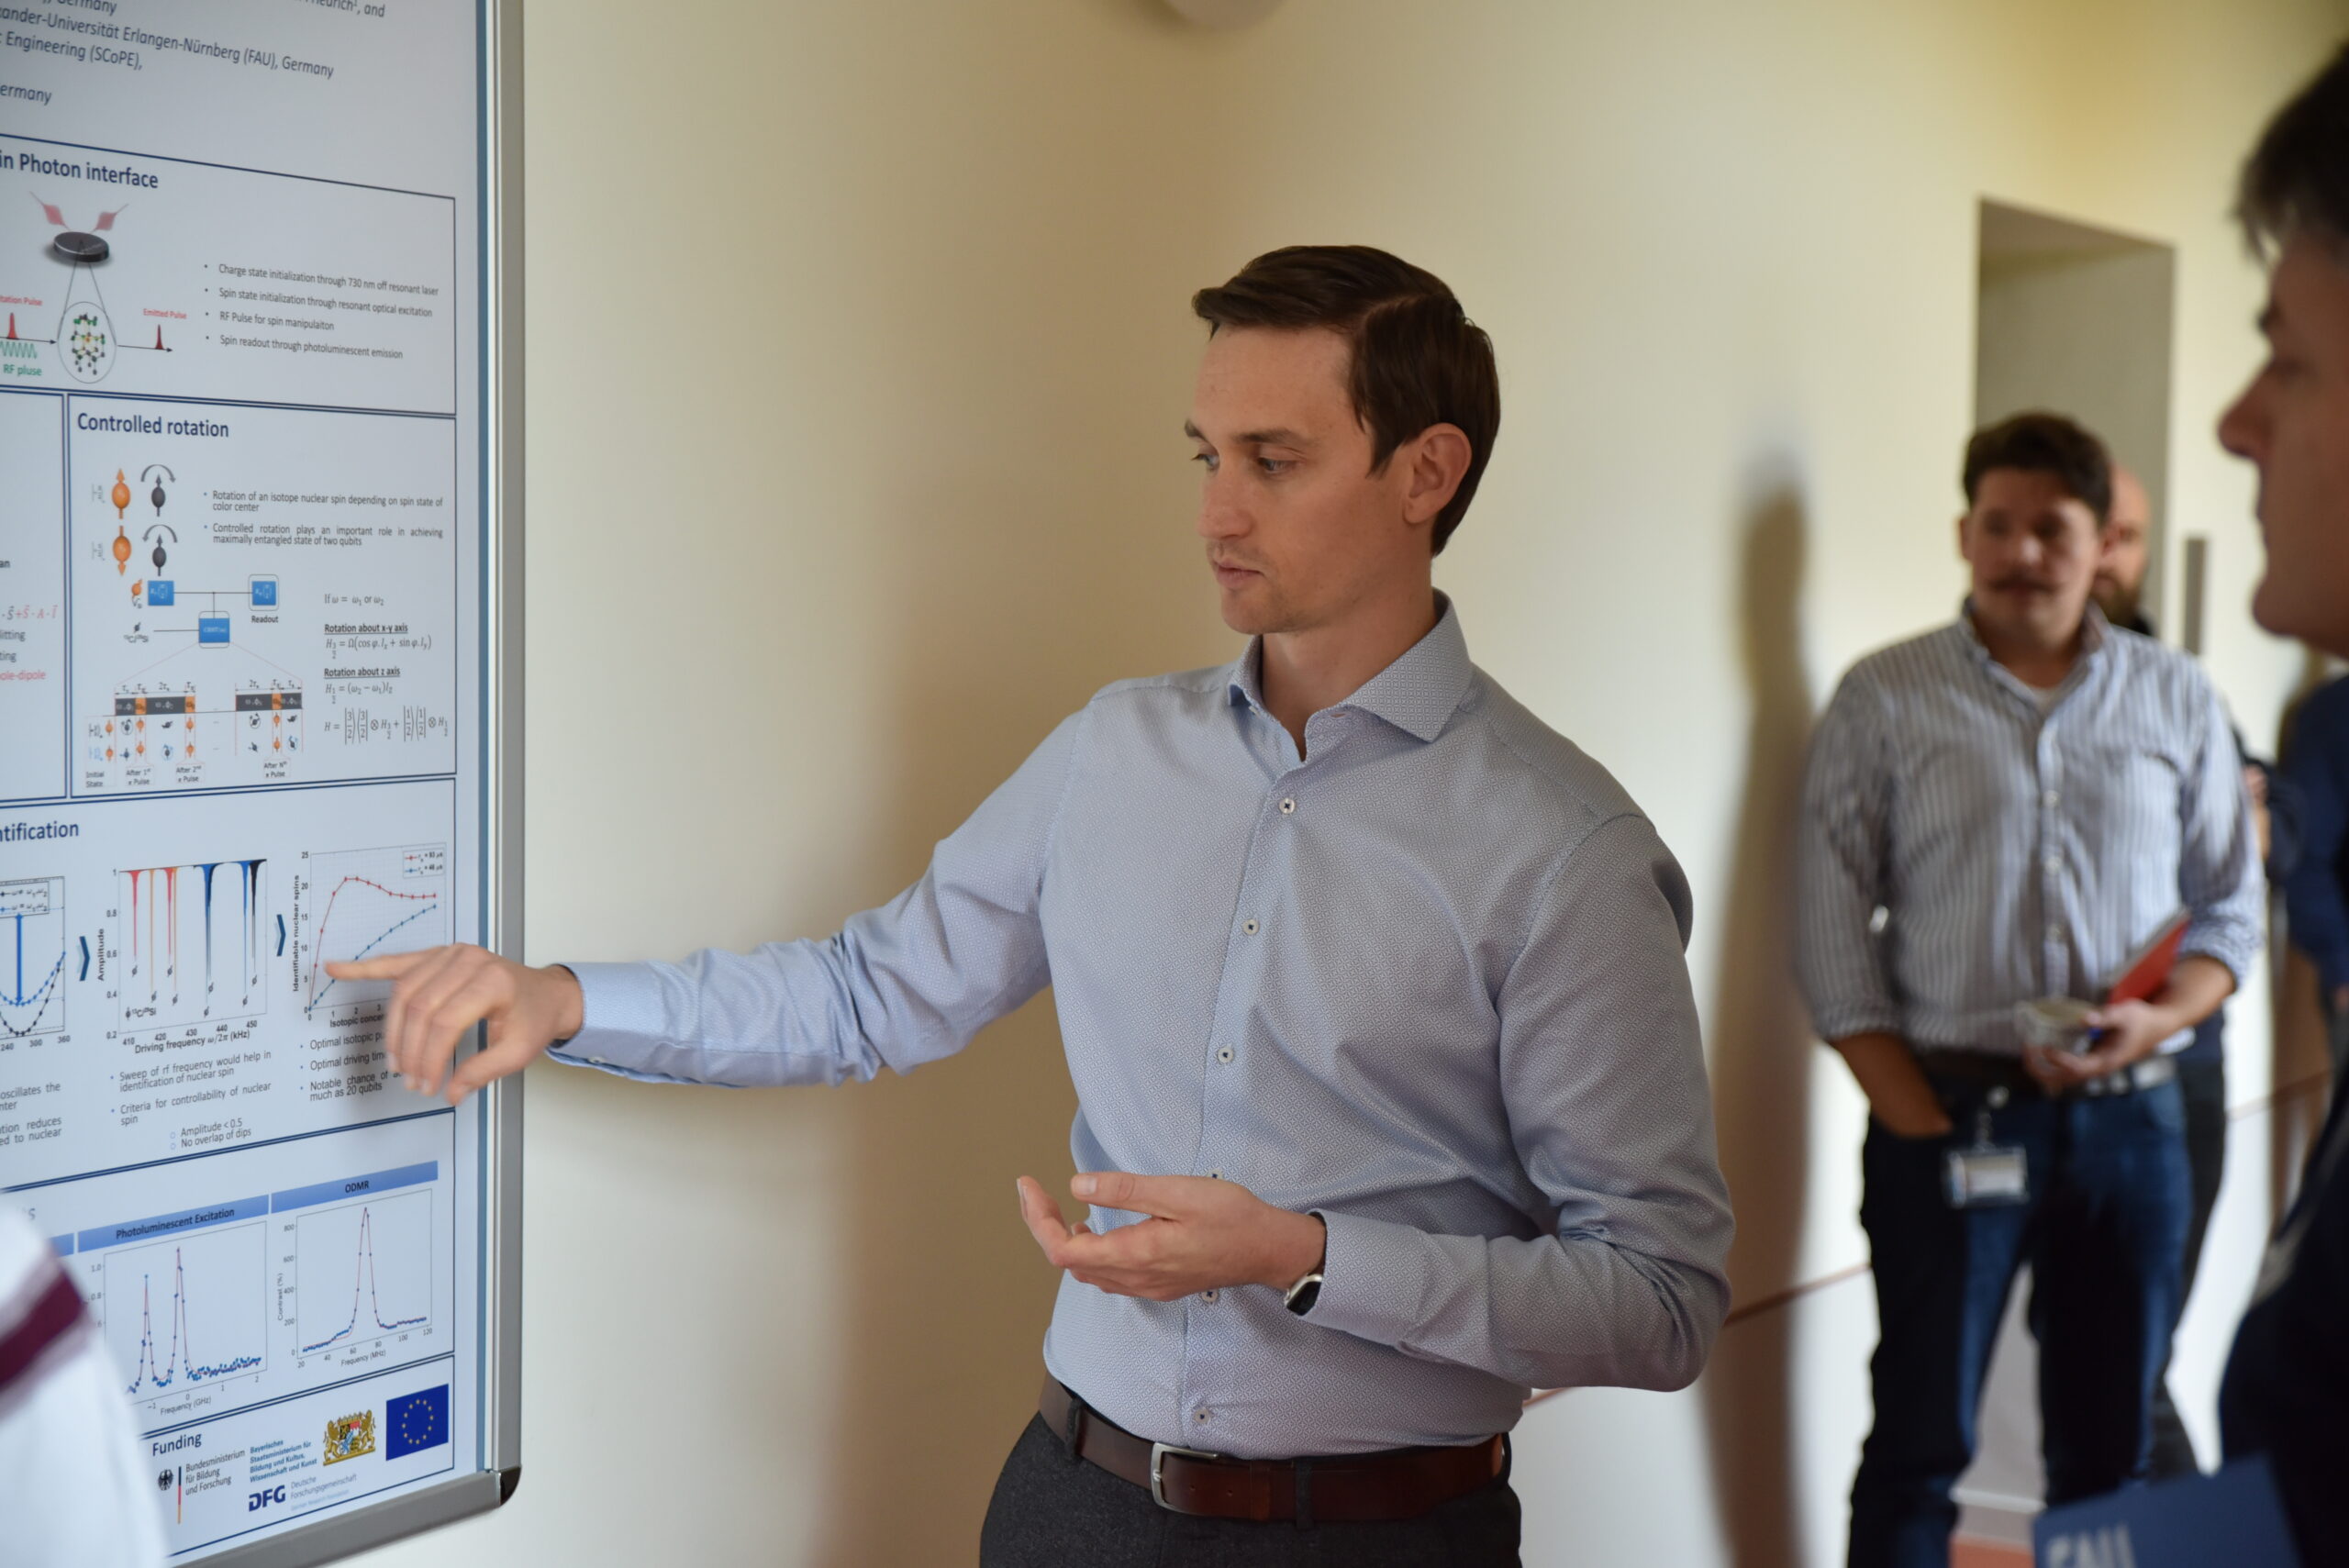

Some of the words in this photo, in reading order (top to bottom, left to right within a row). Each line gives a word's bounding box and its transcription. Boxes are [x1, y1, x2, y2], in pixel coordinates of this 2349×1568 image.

[363, 4, 385, 17] and
[6, 31, 86, 61] Engineering
[90, 45, 142, 71] (SCoPE),
[123, 27, 240, 63] Erlangen-Nürnberg
[243, 48, 279, 70] (FAU),
[282, 56, 334, 80] Germany
[0, 83, 52, 106] ermany
[20, 153, 81, 179] Photon
[86, 161, 159, 189] interface
[218, 263, 247, 277] Charge
[248, 268, 268, 278] state
[270, 269, 316, 284] initialization
[317, 274, 346, 288] through
[348, 277, 362, 288] 730
[363, 281, 375, 289] nm
[377, 281, 387, 291] off
[389, 284, 420, 295] resonant
[421, 285, 440, 296] laser
[219, 287, 237, 300] Spin
[238, 290, 258, 301] state
[259, 291, 306, 306] initialization
[307, 296, 337, 310] through
[339, 301, 371, 312] resonant
[372, 303, 397, 315] optical
[398, 306, 433, 317] excitation
[220, 311, 230, 321] RF
[231, 312, 253, 324] Pulse
[254, 314, 266, 325] for
[267, 317, 284, 328] spin
[220, 334, 238, 347] Spin
[239, 337, 271, 349] readout
[272, 339, 302, 353] through
[303, 342, 371, 357] photoluminescent
[371, 349, 404, 360] emission
[3, 363, 15, 374] RF
[77, 412, 162, 434] Controlled
[167, 418, 229, 438] rotation
[212, 490, 247, 501] Rotation
[248, 491, 257, 502] of
[259, 493, 269, 502] an
[271, 492, 299, 504] isotope
[301, 493, 329, 505] nuclear
[330, 494, 347, 506] spin
[348, 495, 386, 507] depending
[388, 496, 398, 506] on
[399, 496, 415, 507] spin
[416, 497, 434, 507] state
[435, 497, 444, 507] of
[212, 501, 233, 512] color
[234, 503, 260, 512] center
[212, 522, 254, 533] Controlled
[260, 524, 291, 534] rotation
[295, 524, 316, 537] plays
[321, 526, 331, 535] an
[336, 525, 373, 538] important
[378, 526, 393, 537] role
[396, 526, 406, 537] in
[410, 526, 443, 539] achieving
[213, 534, 253, 546] maximally
[254, 535, 293, 547] entangled
[294, 536, 313, 545] state
[314, 535, 322, 546] of
[323, 536, 338, 546] two
[340, 536, 362, 548] qubits
[250, 615, 279, 624] Readout
[324, 623, 356, 633] Rotation
[358, 623, 380, 632] about
[394, 622, 408, 632] axis
[323, 667, 356, 677] Rotation
[357, 666, 380, 676] about
[386, 665, 401, 675] axis
[97, 928, 106, 982] Amplitude
[185, 1028, 198, 1037] 430
[216, 1023, 228, 1032] 440
[245, 1019, 258, 1029] 450
[329, 1018, 359, 1028] Isotopic
[122, 1036, 135, 1046] 410
[135, 1040, 164, 1054] Driving
[165, 1038, 206, 1051] frequency
[230, 1030, 250, 1040] (kHz)
[154, 1032, 167, 1041] 420
[310, 1036, 341, 1051] Optimal
[343, 1031, 374, 1045] isotopic
[119, 1071, 148, 1083] Sweep
[150, 1065, 160, 1077] of
[162, 1065, 170, 1075] rf
[173, 1059, 213, 1073] frequency
[216, 1054, 240, 1067] would
[243, 1051, 262, 1064] help
[263, 1050, 272, 1060] in
[310, 1056, 342, 1071] Optimal
[343, 1051, 370, 1065] driving
[119, 1077, 174, 1093] identification
[176, 1072, 185, 1084] of
[186, 1069, 216, 1083] nuclear
[217, 1066, 235, 1079] spin
[310, 1077, 342, 1092] Notable
[346, 1073, 376, 1085] chance
[380, 1070, 388, 1080] of
[0, 1085, 42, 1100] oscillates
[45, 1082, 61, 1093] the
[120, 1102, 151, 1115] Criteria
[155, 1098, 168, 1109] for
[171, 1089, 226, 1106] controllability
[229, 1085, 239, 1096] of
[242, 1082, 272, 1095] nuclear
[309, 1089, 333, 1102] much
[334, 1088, 344, 1098] as
[346, 1085, 357, 1096] 20
[358, 1082, 383, 1095] qubits
[27, 1117, 62, 1129] reduces
[120, 1115, 139, 1127] spin
[180, 1122, 223, 1139] Amplitude
[230, 1118, 243, 1129] 0.5
[14, 1134, 25, 1143] to
[28, 1128, 62, 1141] nuclear
[181, 1137, 193, 1149] No
[194, 1132, 225, 1147] overlap
[226, 1129, 234, 1140] of
[235, 1127, 251, 1139] dips
[116, 1216, 194, 1240] Photoluminescent
[195, 1207, 235, 1223] Excitation
[344, 1180, 370, 1194] ODMR
[160, 1399, 193, 1416] Frequency
[194, 1396, 212, 1409] (GHz)
[152, 1433, 202, 1457] Funding
[250, 1440, 284, 1454] Bayerisches
[250, 1444, 302, 1464] Staatsministerium
[185, 1450, 246, 1473] Bundesministerium
[250, 1462, 273, 1473] Bildung
[273, 1458, 285, 1466] und
[250, 1466, 288, 1484] Wissenschaft
[288, 1462, 300, 1472] und
[300, 1458, 317, 1468] Kunst
[185, 1474, 195, 1485] für
[195, 1468, 221, 1482] Bildung
[185, 1485, 198, 1496] und
[199, 1476, 232, 1492] Forschung
[249, 1484, 286, 1512] DFG
